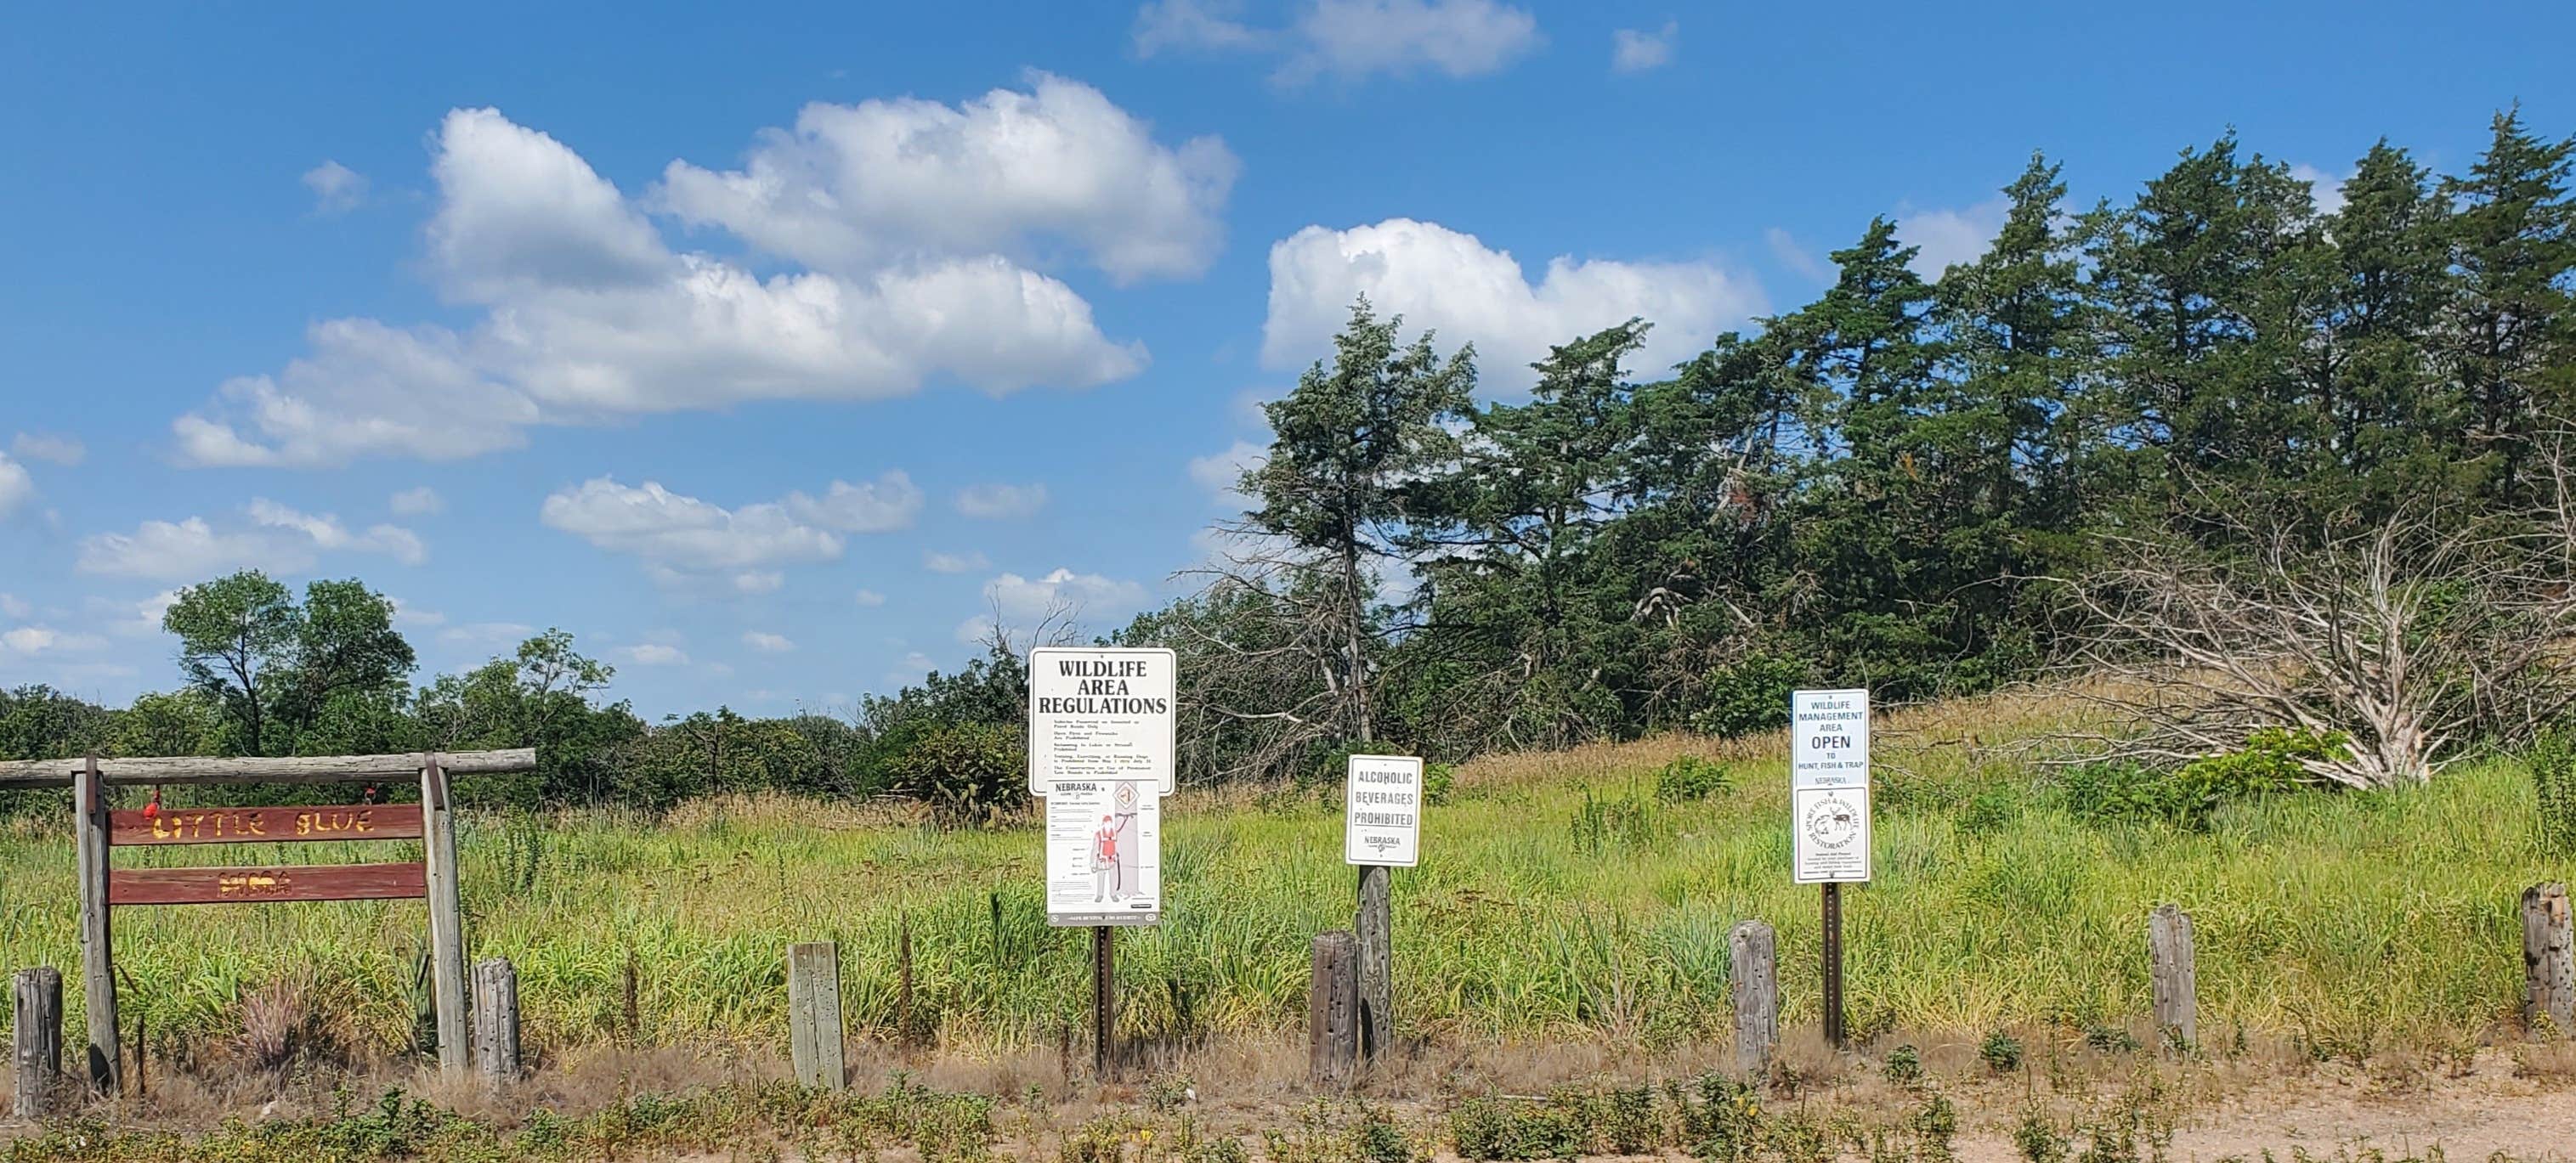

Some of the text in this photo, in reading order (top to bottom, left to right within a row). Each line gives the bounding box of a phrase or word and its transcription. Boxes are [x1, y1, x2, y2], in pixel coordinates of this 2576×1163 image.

[1059, 660, 1146, 677] WILDLIFE
[1078, 680, 1129, 695] AREA
[1039, 697, 1167, 714] REGULATIONS
[1811, 701, 1850, 709] WILDLIFE
[1798, 712, 1863, 721] MANAGEMENT
[1812, 736, 1851, 749] OPEN
[1798, 762, 1820, 771] HUNT,
[1358, 771, 1413, 784] ALCOHOLIC
[1056, 782, 1097, 792] NEBRASKA
[1356, 792, 1413, 805] BEVERAGES
[1814, 798, 1831, 810] FISH
[153, 810, 374, 839] LITTLE BLUE
[1355, 812, 1413, 825] PROHIBITED
[1364, 836, 1401, 845] NEBRASKA
[1809, 831, 1856, 849] RESTORATION
